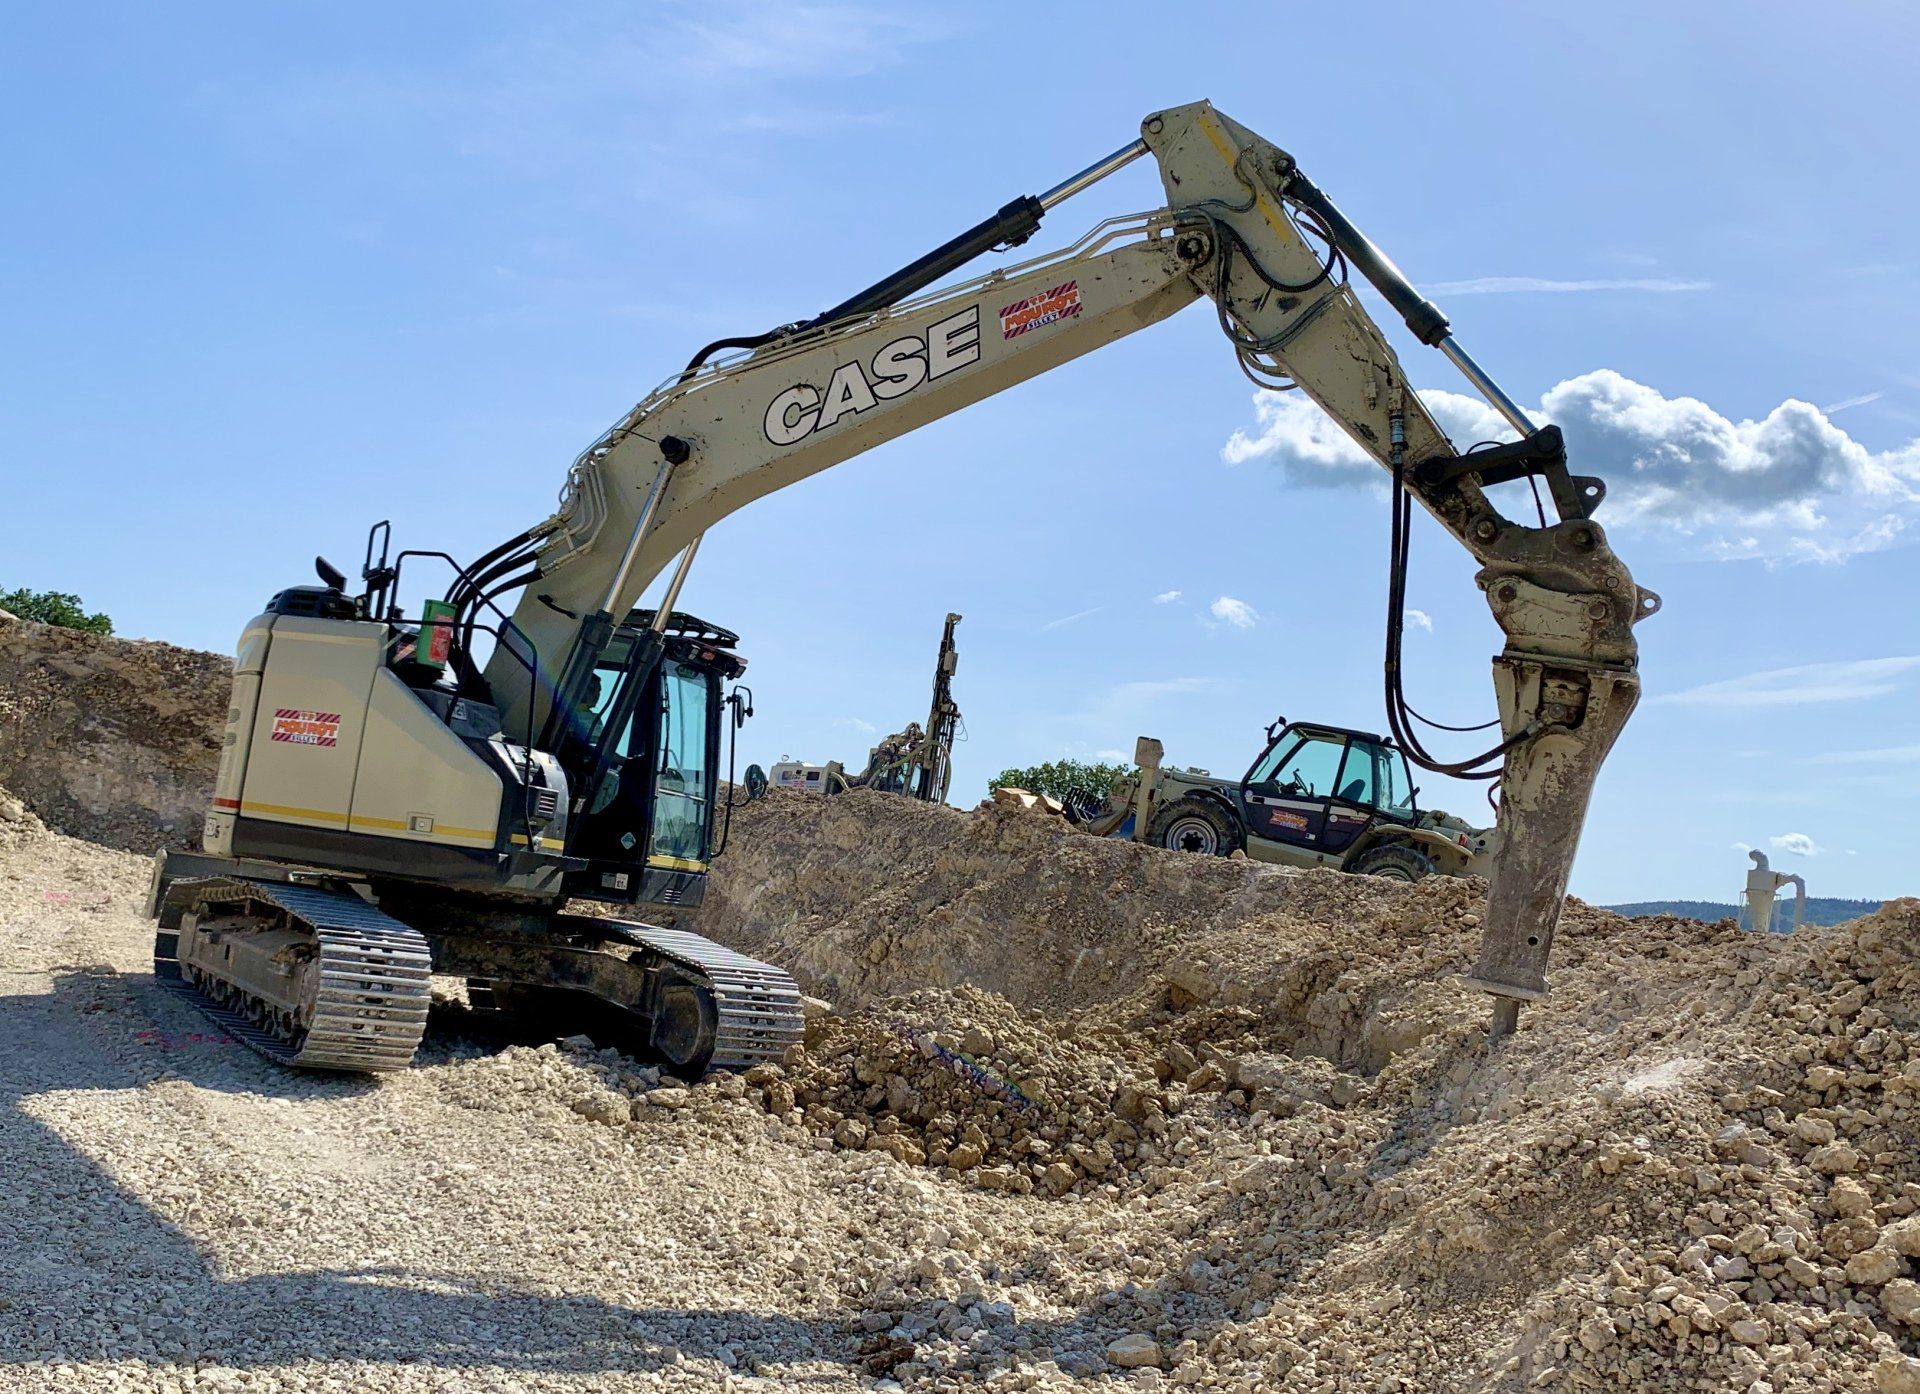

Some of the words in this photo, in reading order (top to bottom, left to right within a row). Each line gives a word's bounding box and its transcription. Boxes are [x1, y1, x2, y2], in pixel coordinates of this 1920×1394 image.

[1028, 294, 1048, 305] TP
[1005, 290, 1078, 330] MOUROT
[1028, 314, 1058, 328] SILLEY
[764, 304, 980, 446] CASE
[275, 720, 337, 737] MOUROT
